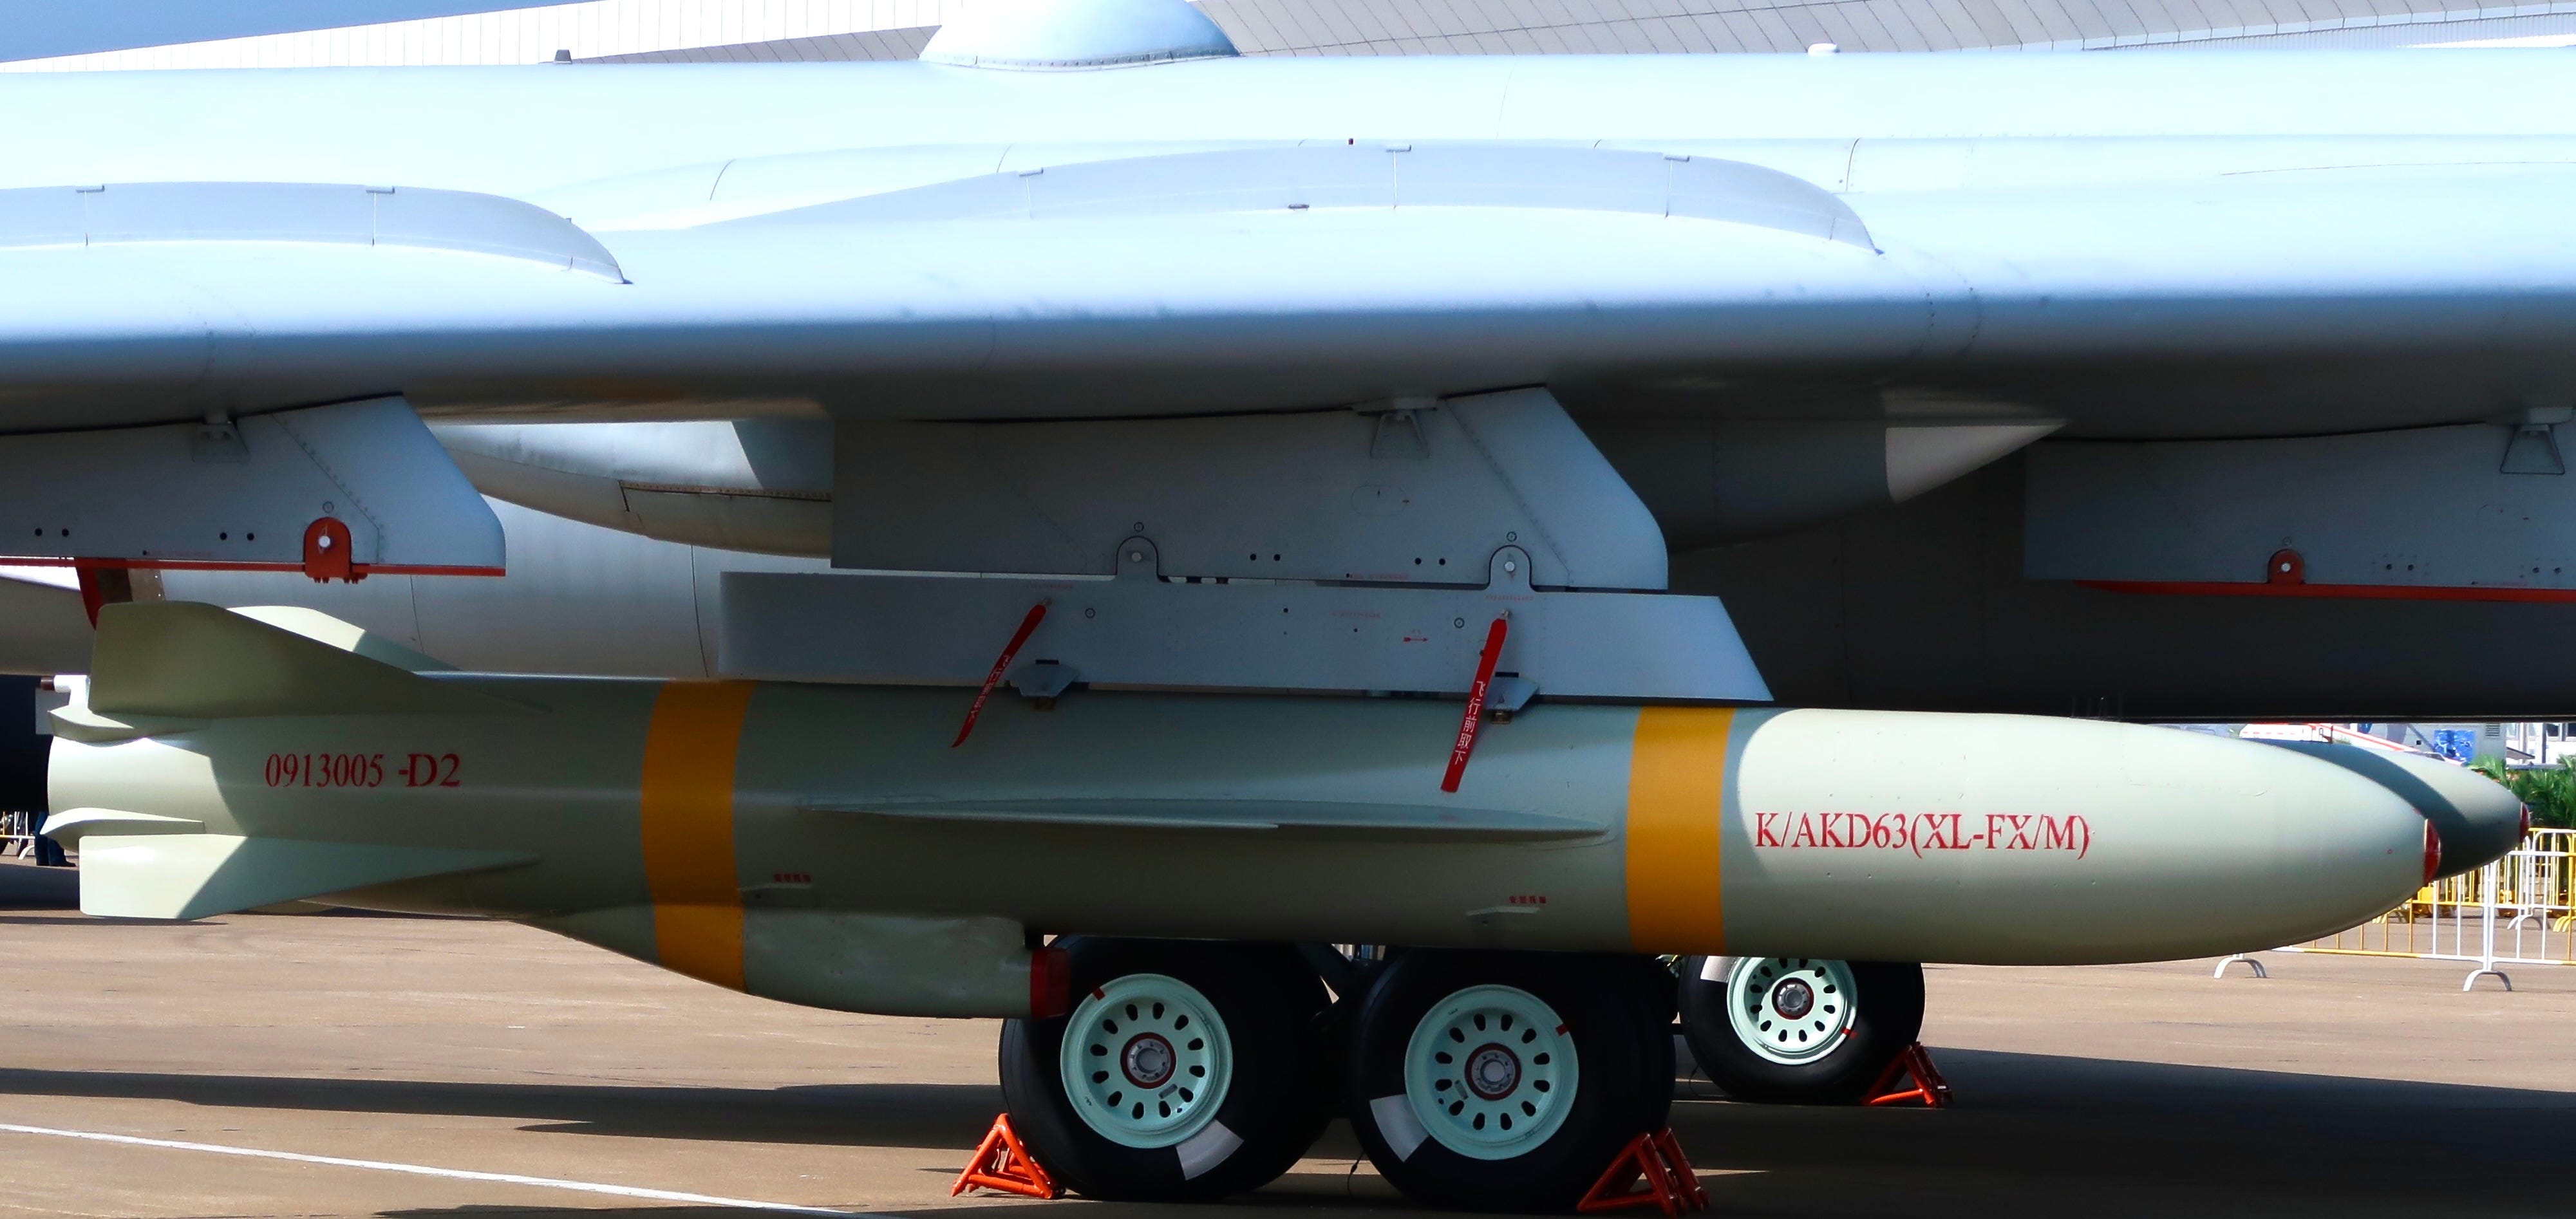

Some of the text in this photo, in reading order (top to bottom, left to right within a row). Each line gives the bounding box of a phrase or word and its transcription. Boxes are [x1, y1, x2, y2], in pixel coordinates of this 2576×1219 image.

[1454, 680, 1486, 765] 飞行前取下
[265, 753, 384, 788] 0913005
[1754, 812, 2091, 860] K/AKD63(XL-FX/M)
